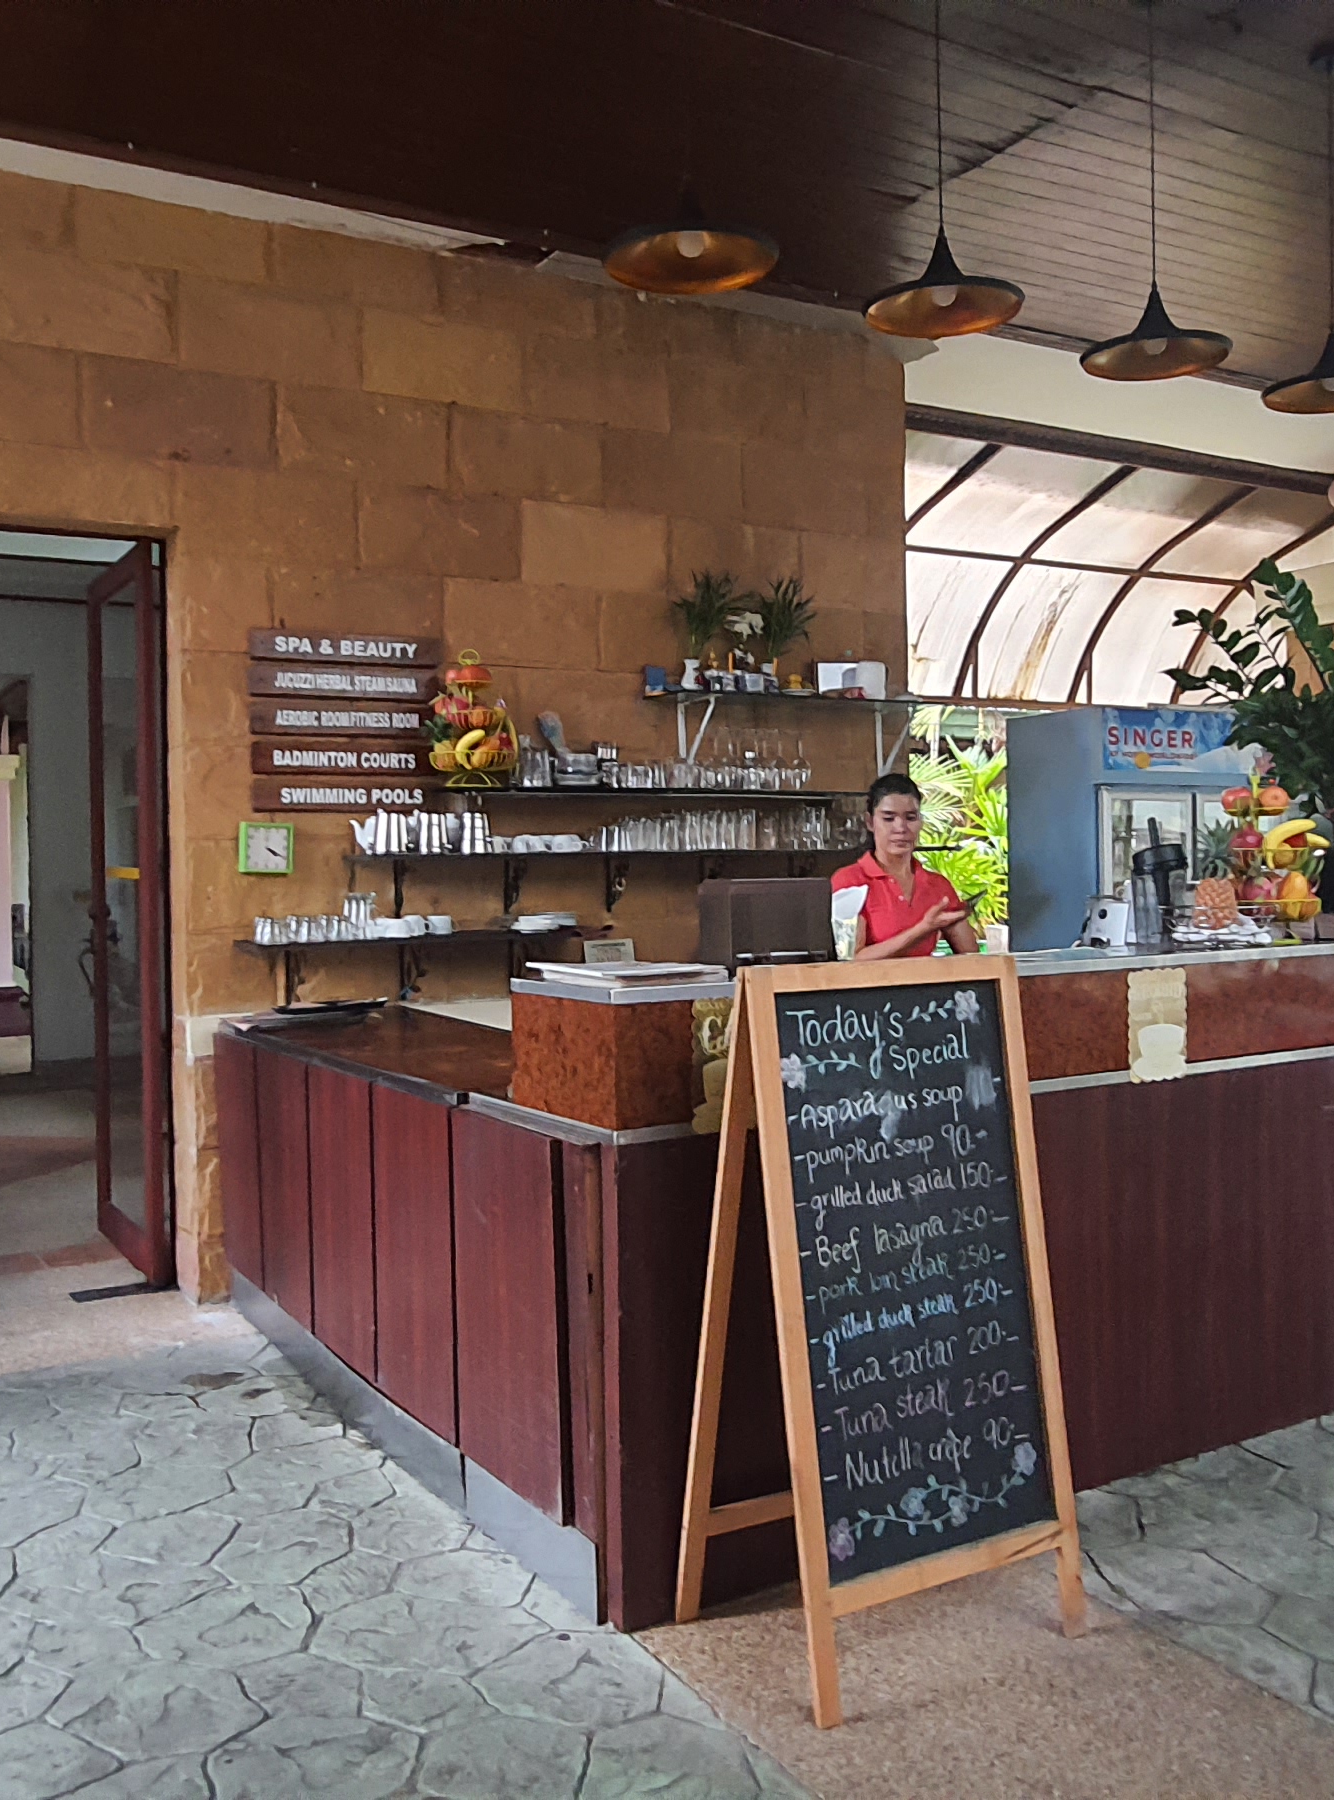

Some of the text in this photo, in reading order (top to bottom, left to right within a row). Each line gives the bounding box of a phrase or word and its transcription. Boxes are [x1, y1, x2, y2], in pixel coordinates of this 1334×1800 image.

[275, 636, 417, 658] SPA & BEAUTY
[316, 674, 353, 691] HERBAL
[354, 675, 386, 692] STEAM
[386, 677, 417, 693] SAUNA
[275, 709, 419, 729] AEROBIC ROOM FITNESS ROOM
[1107, 725, 1194, 748] SINGER
[273, 750, 416, 769] BADMINTON COURTS
[281, 788, 423, 804] SWIMMING POOLS
[785, 1002, 903, 1079] Today's
[923, 1085, 962, 1121] soup
[894, 1135, 934, 1164] soup
[866, 1179, 903, 1206] duck
[907, 1166, 956, 1195] salad
[873, 1215, 947, 1266] lasagna
[901, 1253, 954, 1285] steak
[878, 1303, 916, 1330] duck
[918, 1294, 959, 1321] steak
[889, 1336, 957, 1378] tartar
[896, 1378, 955, 1418] steak
